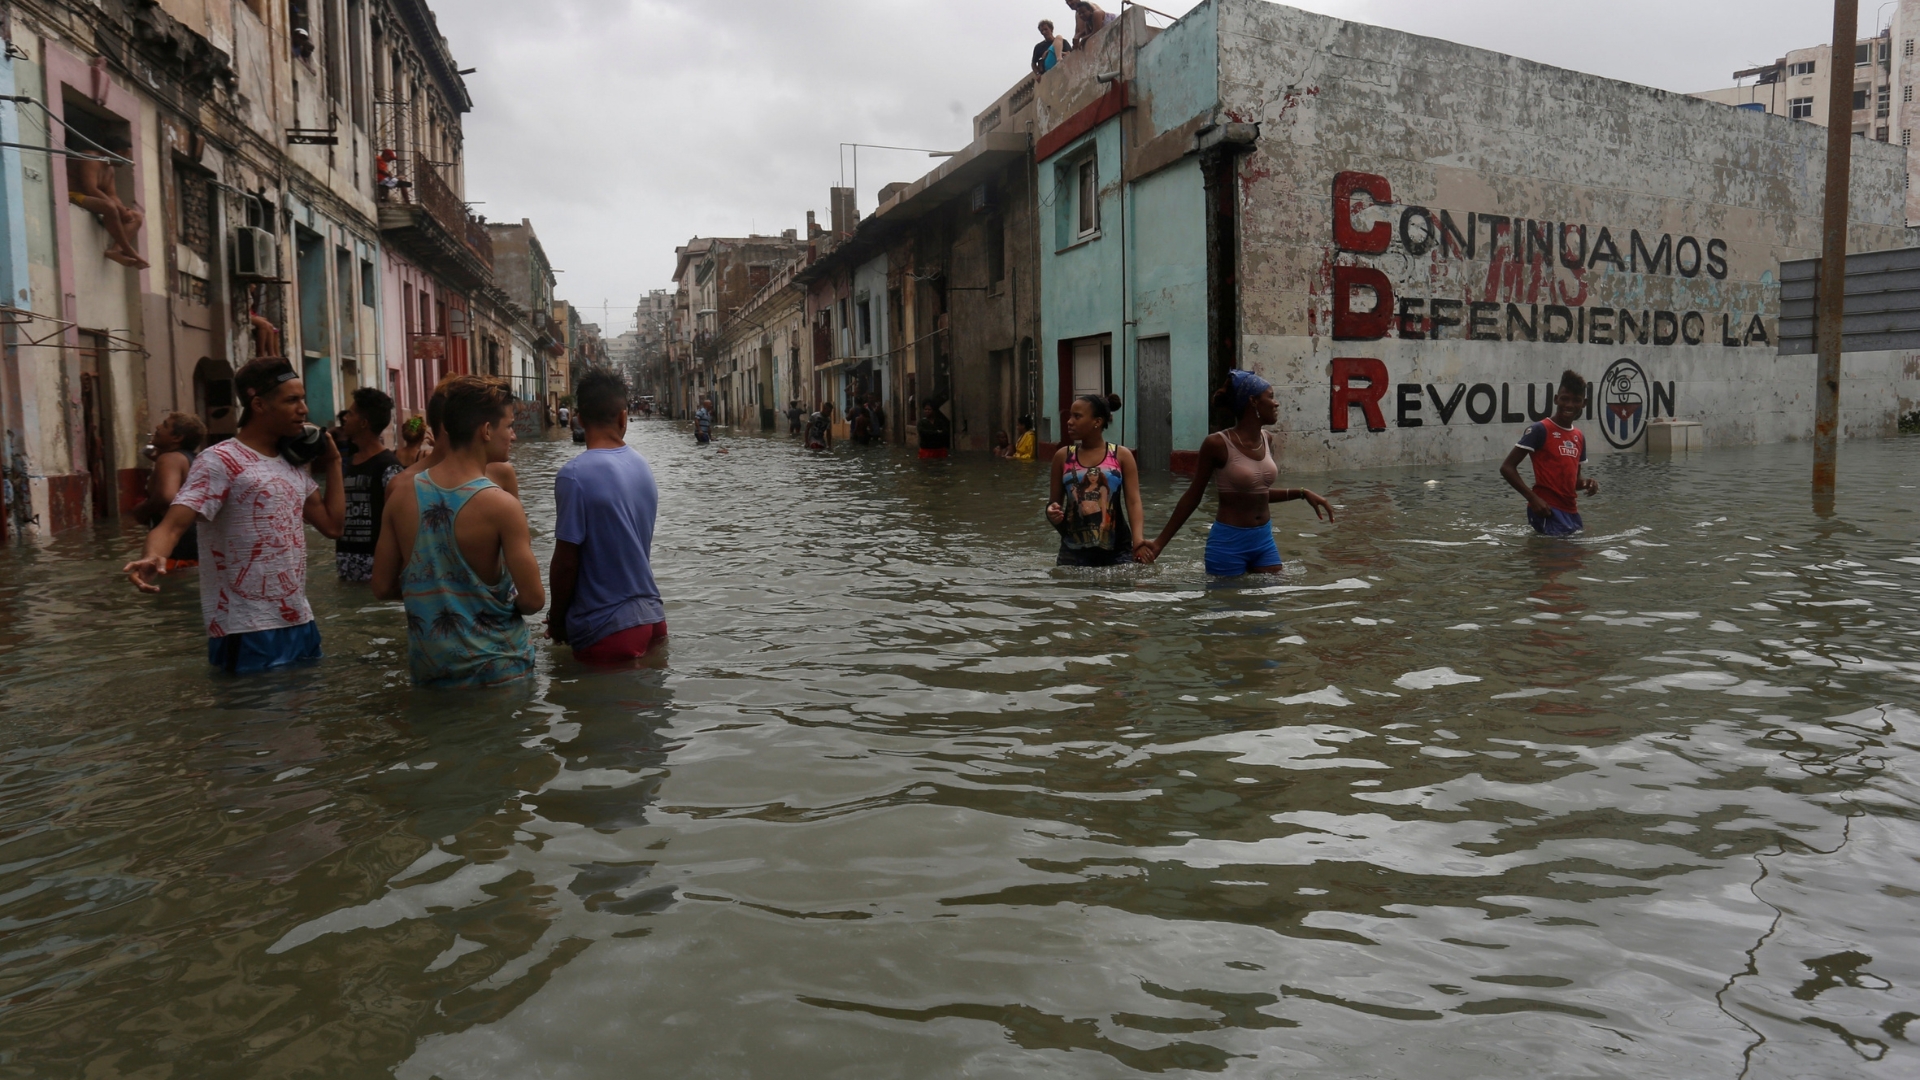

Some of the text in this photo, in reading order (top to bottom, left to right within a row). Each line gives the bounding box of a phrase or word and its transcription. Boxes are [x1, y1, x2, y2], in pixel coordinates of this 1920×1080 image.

[1332, 171, 1728, 280] CONTINUAMOS
[1332, 265, 1704, 346] DEFENDIENDO
[1723, 313, 1770, 347] LA
